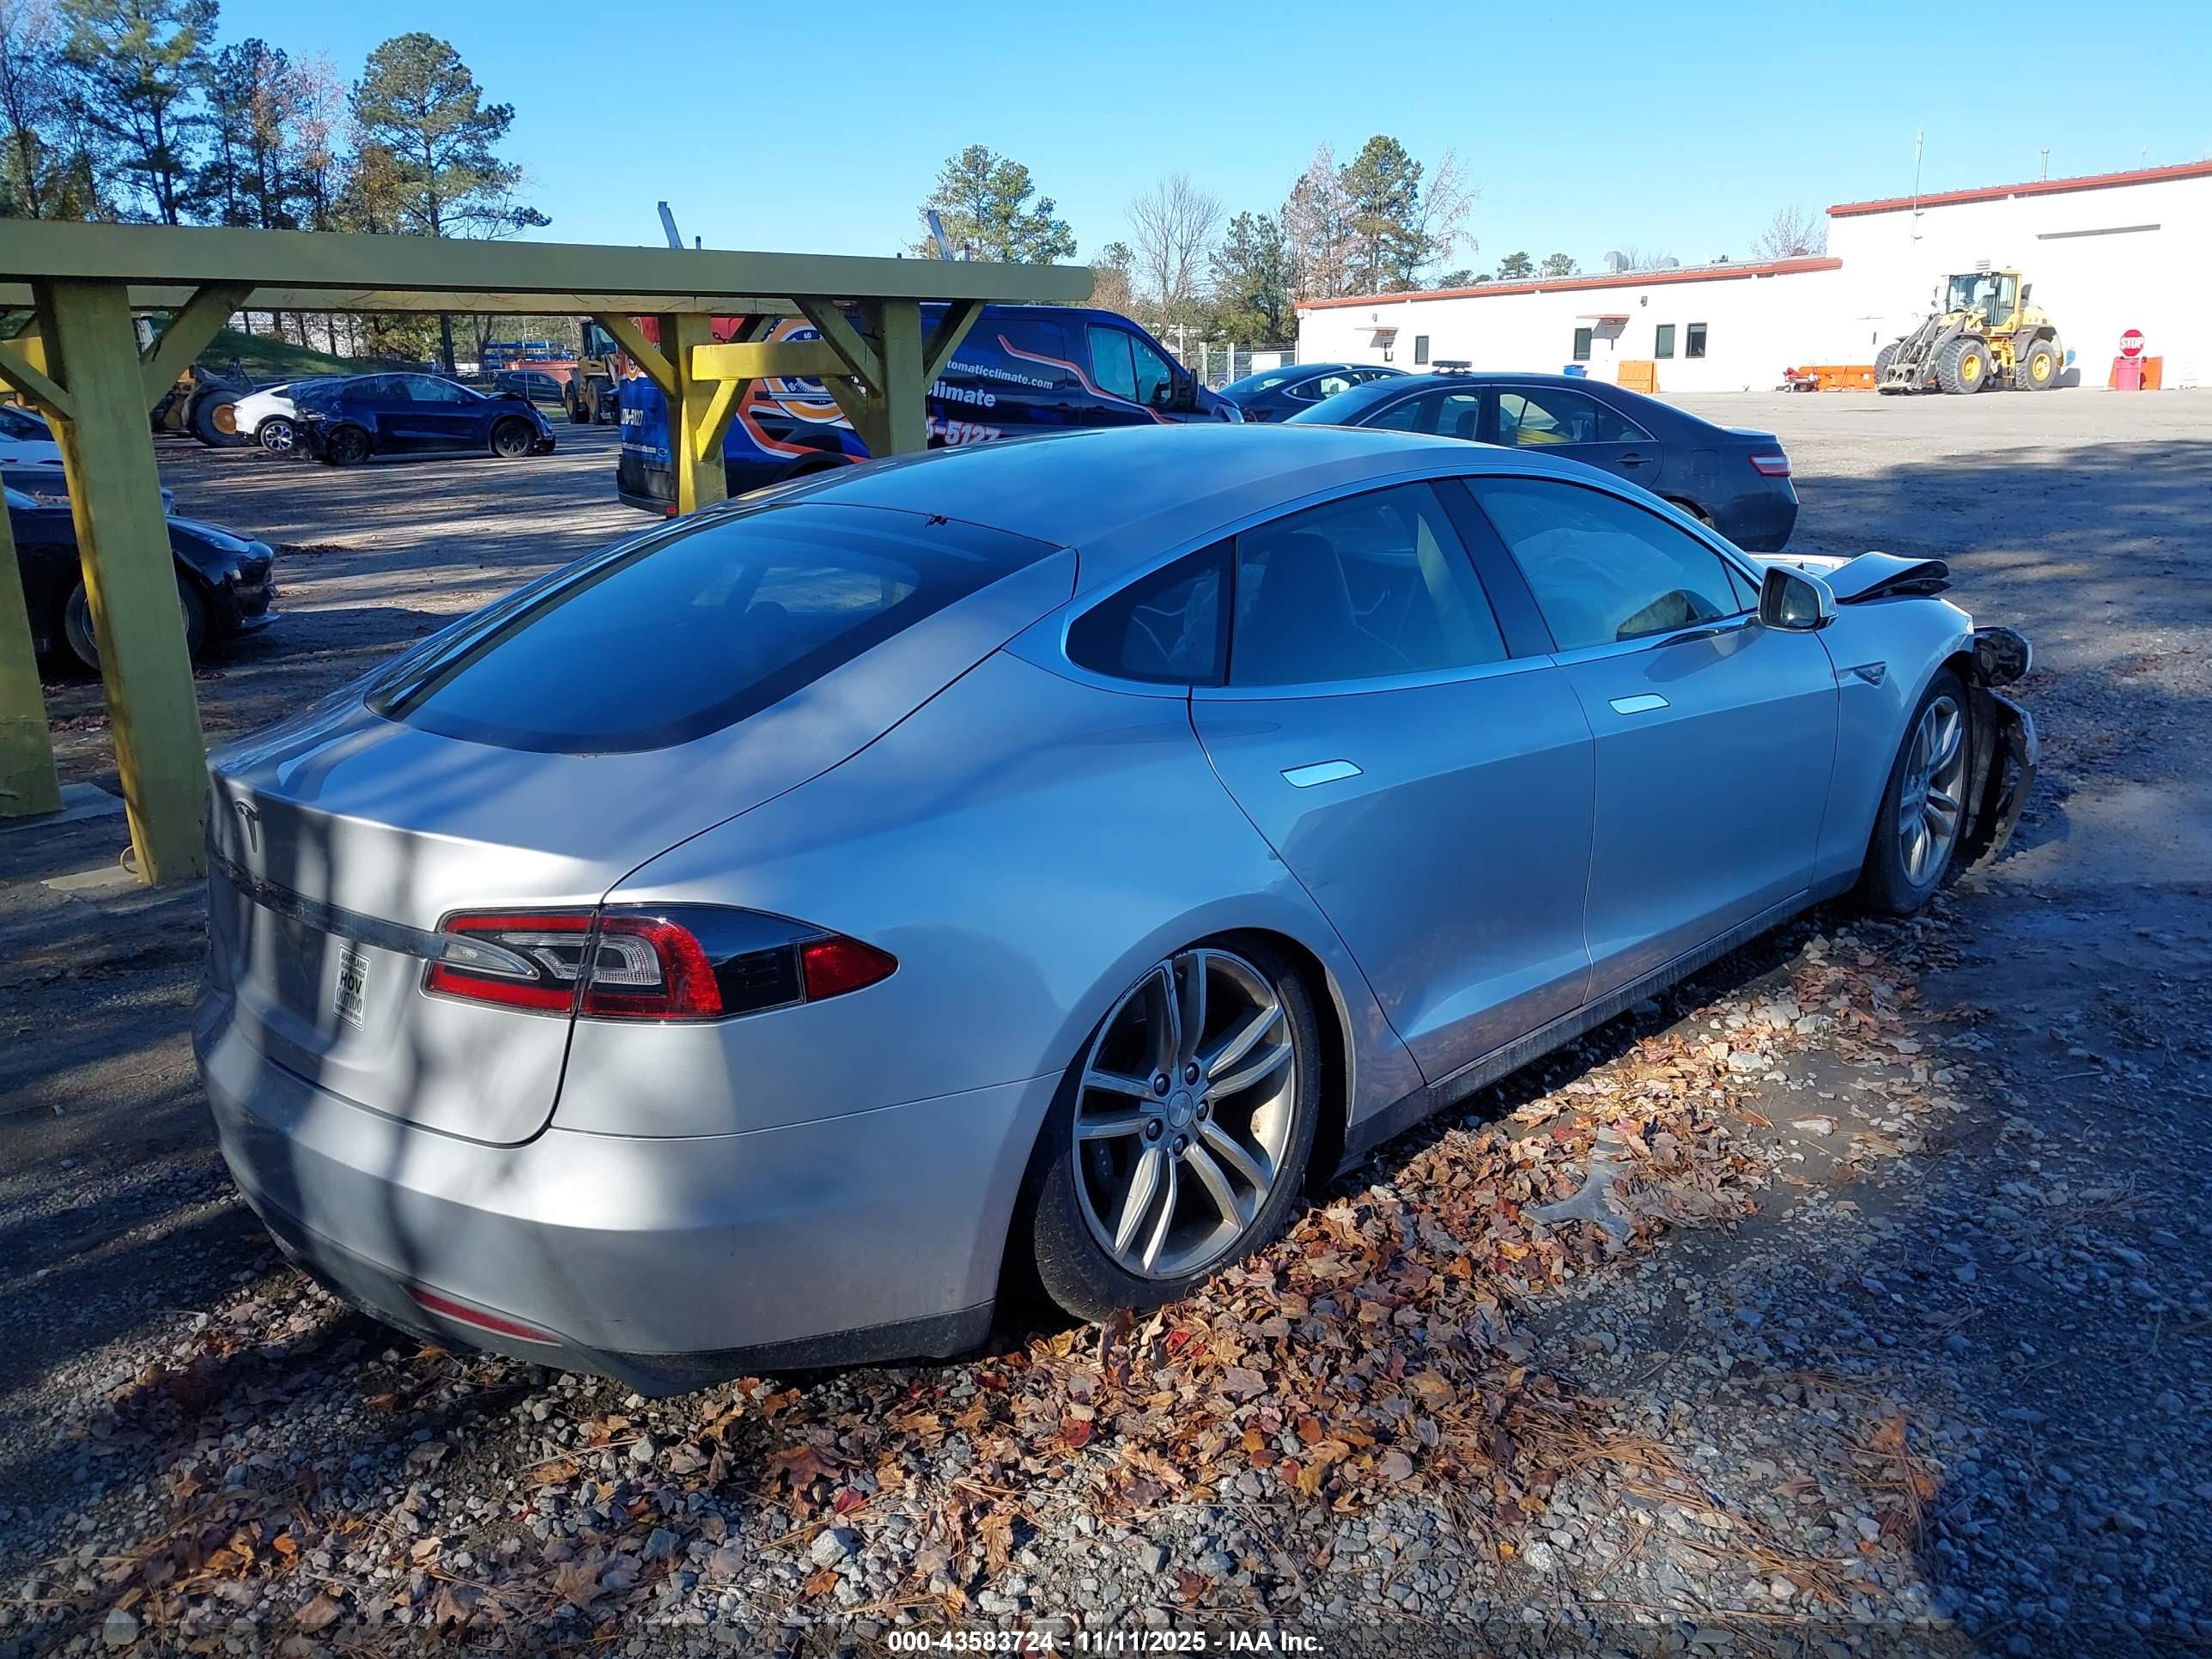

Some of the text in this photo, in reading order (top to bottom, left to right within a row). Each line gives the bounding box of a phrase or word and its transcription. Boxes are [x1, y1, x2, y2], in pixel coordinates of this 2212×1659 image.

[2121, 337, 2144, 349] STOP
[927, 380, 996, 408] limate
[340, 970, 362, 994] HOV
